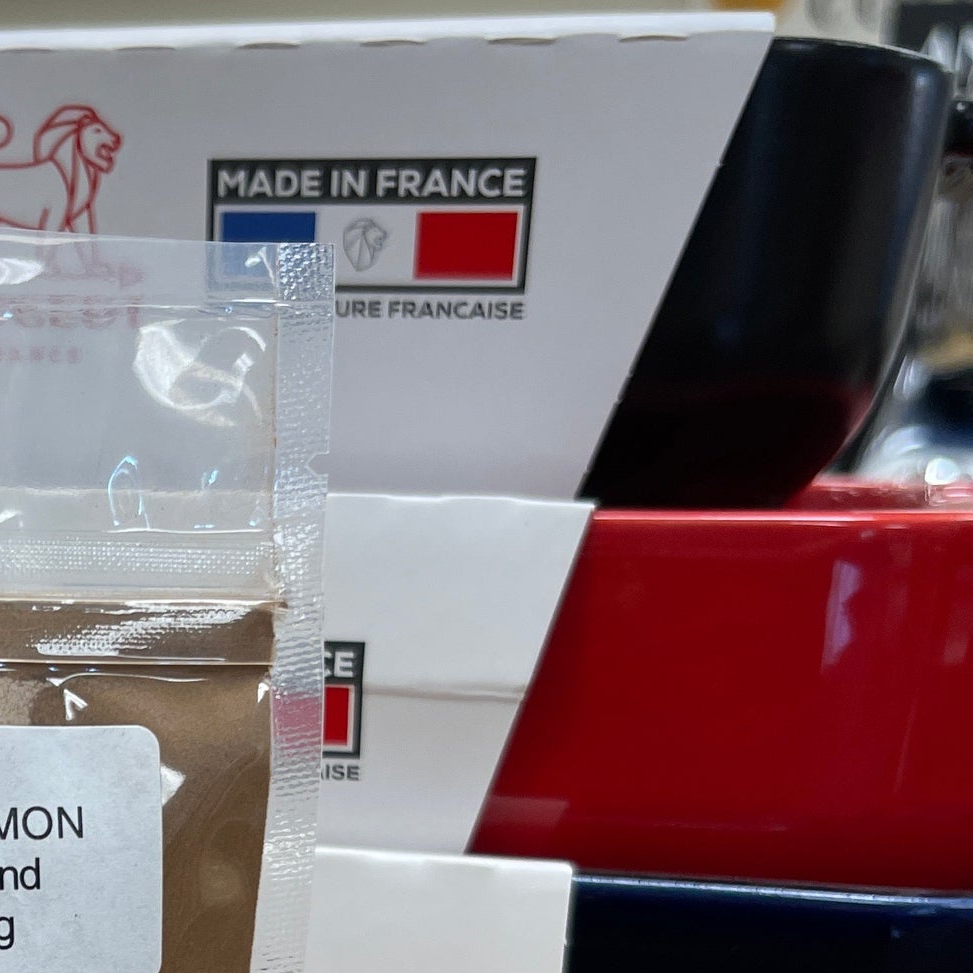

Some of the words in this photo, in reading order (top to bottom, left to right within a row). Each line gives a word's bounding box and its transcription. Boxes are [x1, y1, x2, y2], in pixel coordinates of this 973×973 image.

[217, 168, 322, 198] MADE
[330, 169, 367, 198] IN
[376, 168, 527, 197] FRANCE
[387, 301, 525, 320] FRANCAISE
